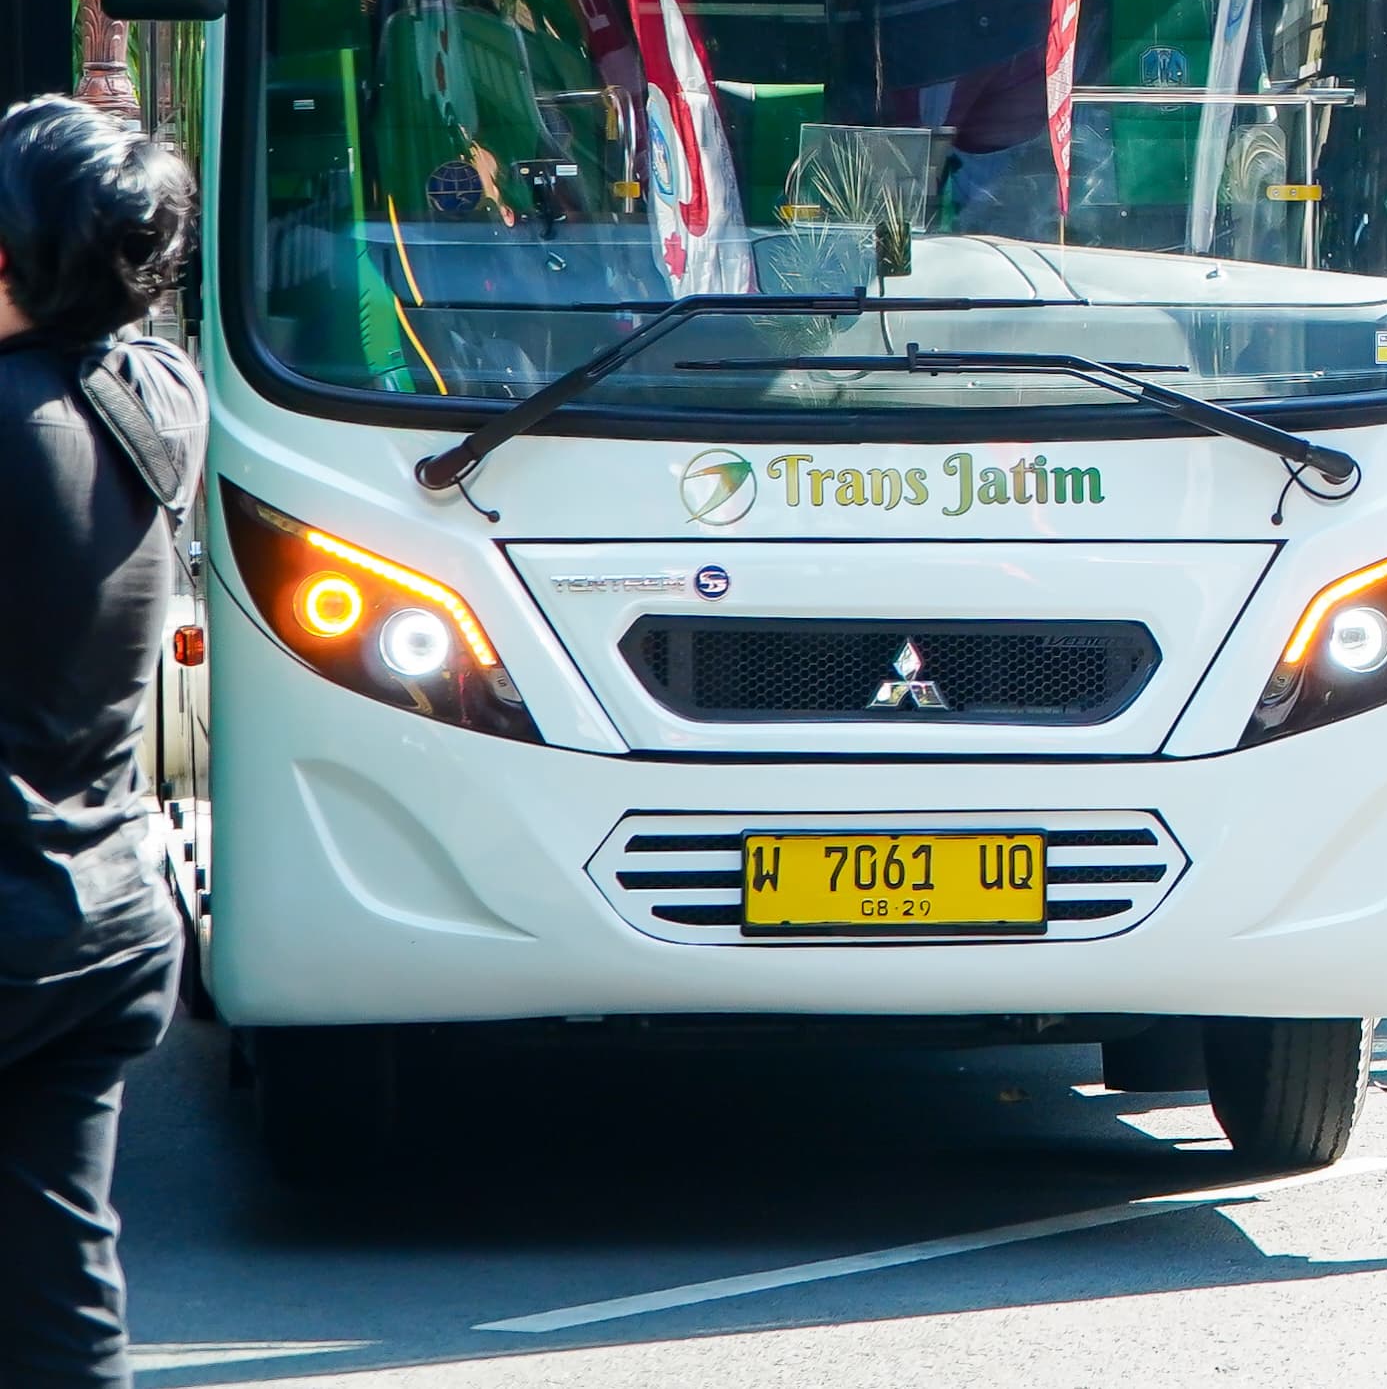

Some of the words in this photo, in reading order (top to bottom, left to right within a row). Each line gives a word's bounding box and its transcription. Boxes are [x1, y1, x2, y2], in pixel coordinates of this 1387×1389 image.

[766, 453, 928, 511] Trans
[941, 452, 1106, 517] Jatim
[751, 846, 781, 892] W
[824, 844, 937, 893] 7061
[979, 844, 1034, 891] UQ
